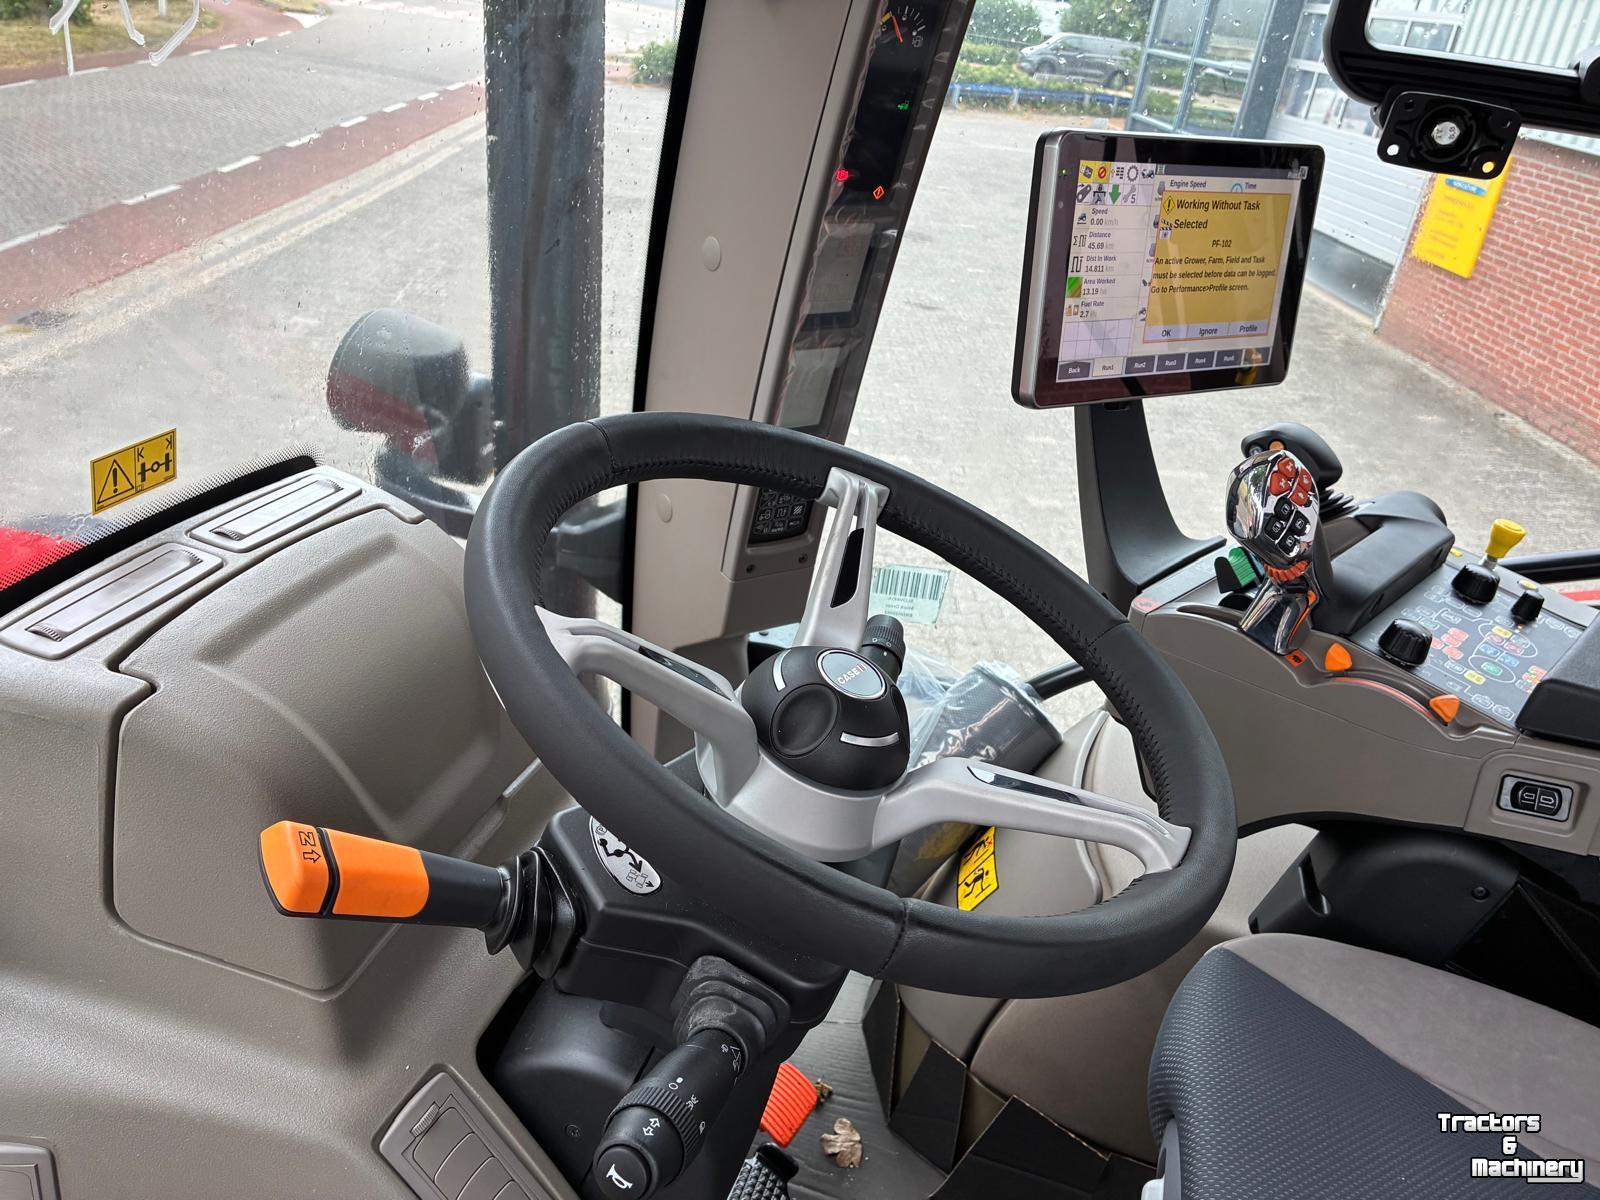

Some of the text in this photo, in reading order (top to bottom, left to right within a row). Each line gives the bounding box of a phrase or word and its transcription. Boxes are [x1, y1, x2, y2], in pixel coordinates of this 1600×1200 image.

[1169, 179, 1207, 189] Engine Speed
[1130, 194, 1136, 204] 5
[1176, 199, 1261, 211] Working Without Task
[1091, 208, 1108, 216] Speed
[1090, 218, 1104, 226] 0.00
[1173, 219, 1208, 229] Selected
[1087, 242, 1105, 250] 45.69
[1211, 239, 1233, 248] PF-102
[1184, 257, 1207, 265] Grower,
[1208, 256, 1225, 265] Farm,
[1226, 256, 1240, 264] Field
[1253, 255, 1265, 263] Task
[1084, 265, 1104, 273] 14.811
[1152, 271, 1169, 280] must
[1169, 271, 1179, 279] be
[1178, 270, 1203, 279] selected
[1204, 270, 1223, 278] before
[1224, 269, 1236, 277] data
[1248, 269, 1256, 277] be
[1096, 277, 1116, 285] Worked
[1082, 288, 1099, 296] 13.19
[1150, 285, 1160, 294] Go
[1168, 284, 1228, 293] Performance>Profile
[1228, 284, 1249, 292] screen.
[1080, 300, 1093, 308] Fuel
[1079, 310, 1089, 318] 2.7
[1198, 327, 1218, 337] Ignore
[1239, 324, 1259, 333] Profile
[1161, 329, 1171, 338] OK
[836, 667, 861, 685] CASE
